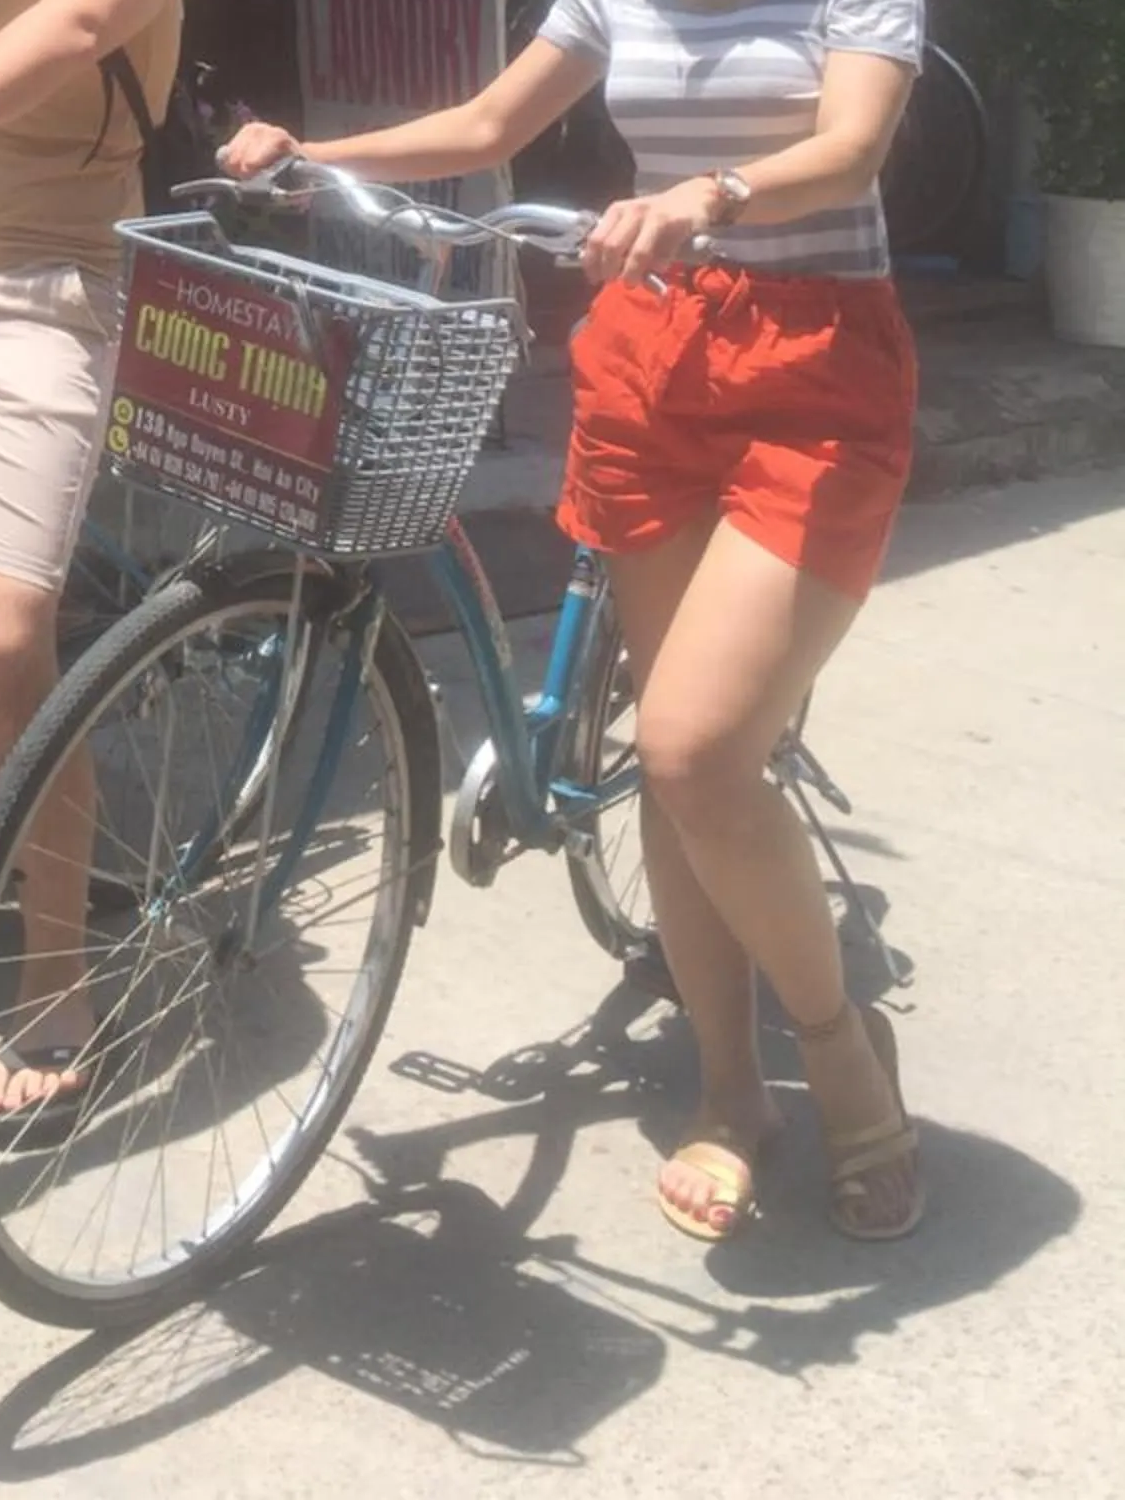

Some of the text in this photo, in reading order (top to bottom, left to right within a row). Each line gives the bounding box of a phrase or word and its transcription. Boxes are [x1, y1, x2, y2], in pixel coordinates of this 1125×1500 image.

[177, 277, 301, 343] HOMESTAY
[134, 407, 165, 437] 138
[189, 387, 251, 426] LUSTY
